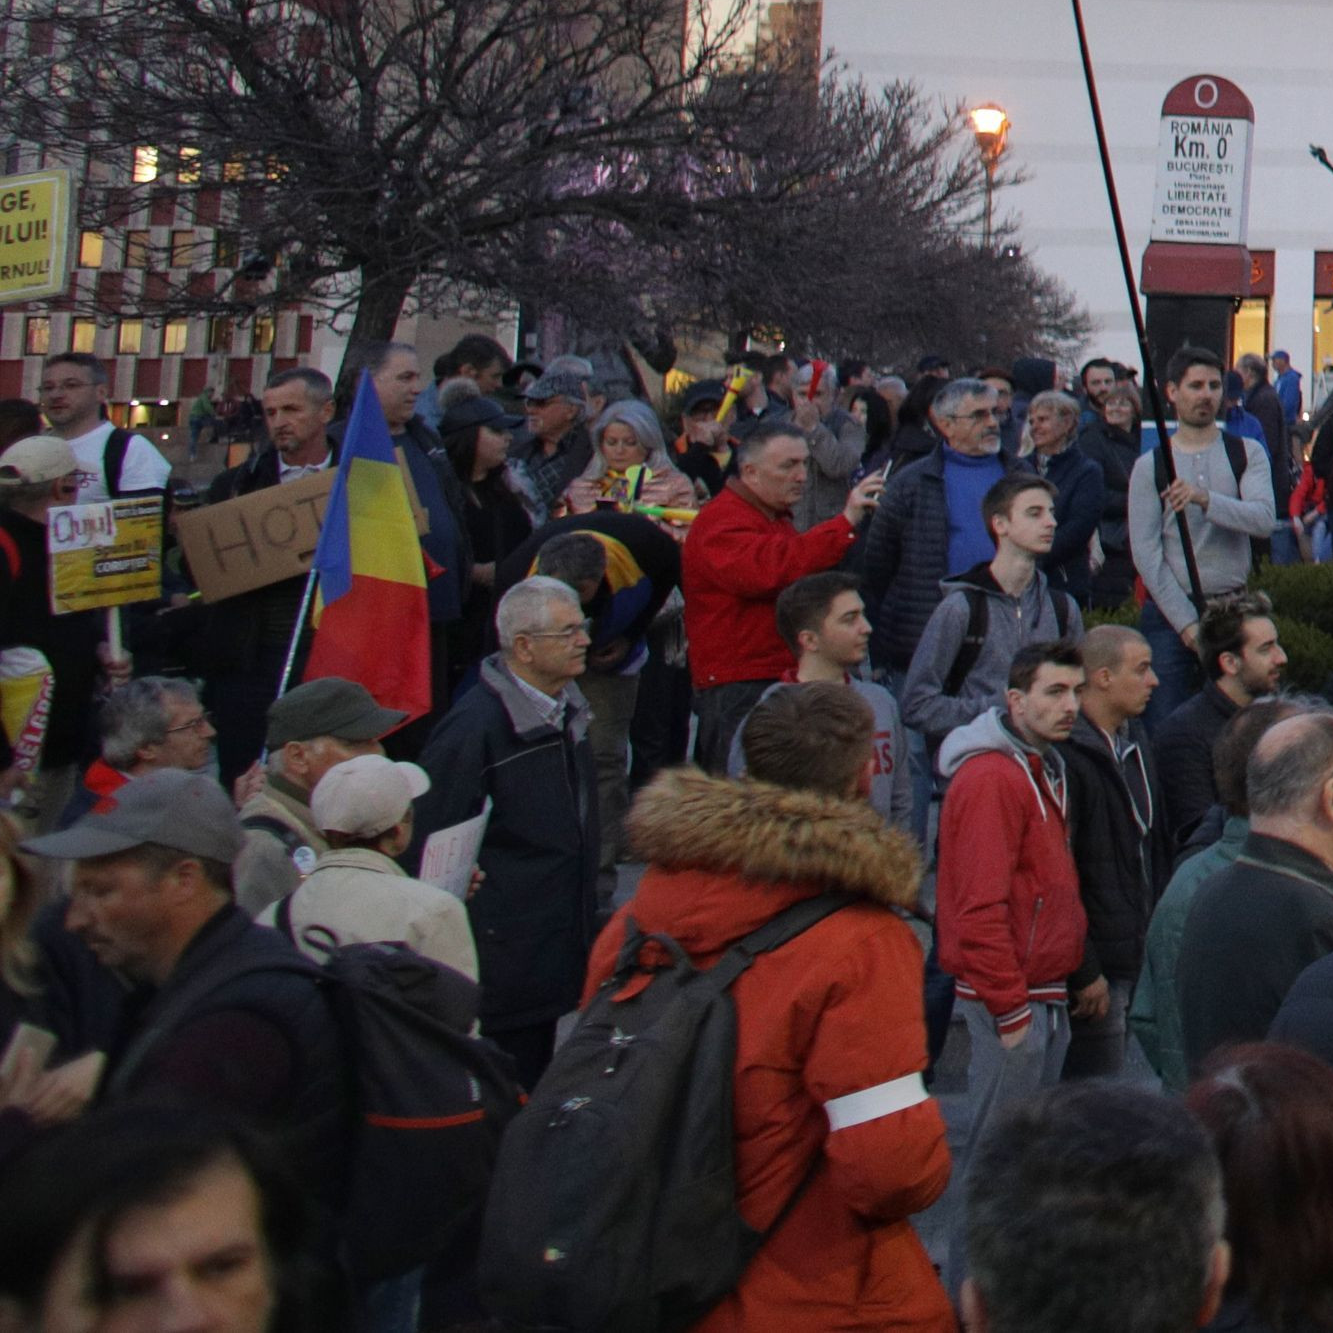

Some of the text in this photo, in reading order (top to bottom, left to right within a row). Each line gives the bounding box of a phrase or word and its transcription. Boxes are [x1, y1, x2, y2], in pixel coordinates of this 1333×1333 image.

[1175, 136, 1210, 159] Km.
[1167, 191, 1228, 202] LIBERTATE
[0, 219, 48, 245] LUI!
